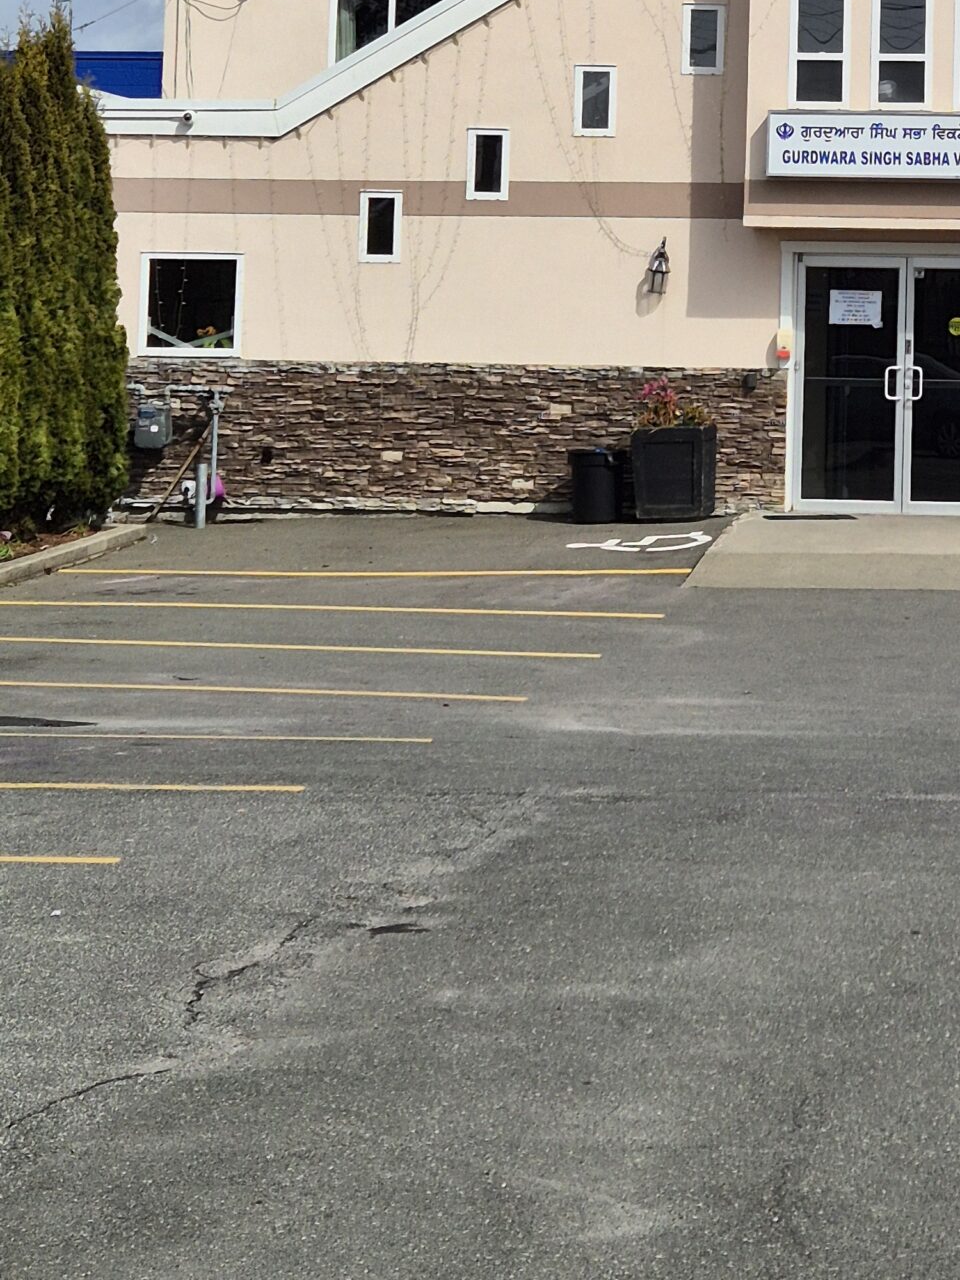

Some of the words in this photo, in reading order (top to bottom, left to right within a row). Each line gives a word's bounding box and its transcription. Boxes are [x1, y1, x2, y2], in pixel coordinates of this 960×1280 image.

[801, 126, 865, 142] ਗੁਰਦੁਆਰਾ
[870, 122, 898, 139] ਸਿੰਘ
[902, 127, 927, 140] ਸਭਾ
[782, 149, 857, 166] GURDWARA
[861, 151, 901, 166] SINGH
[906, 152, 950, 167] SABHA
